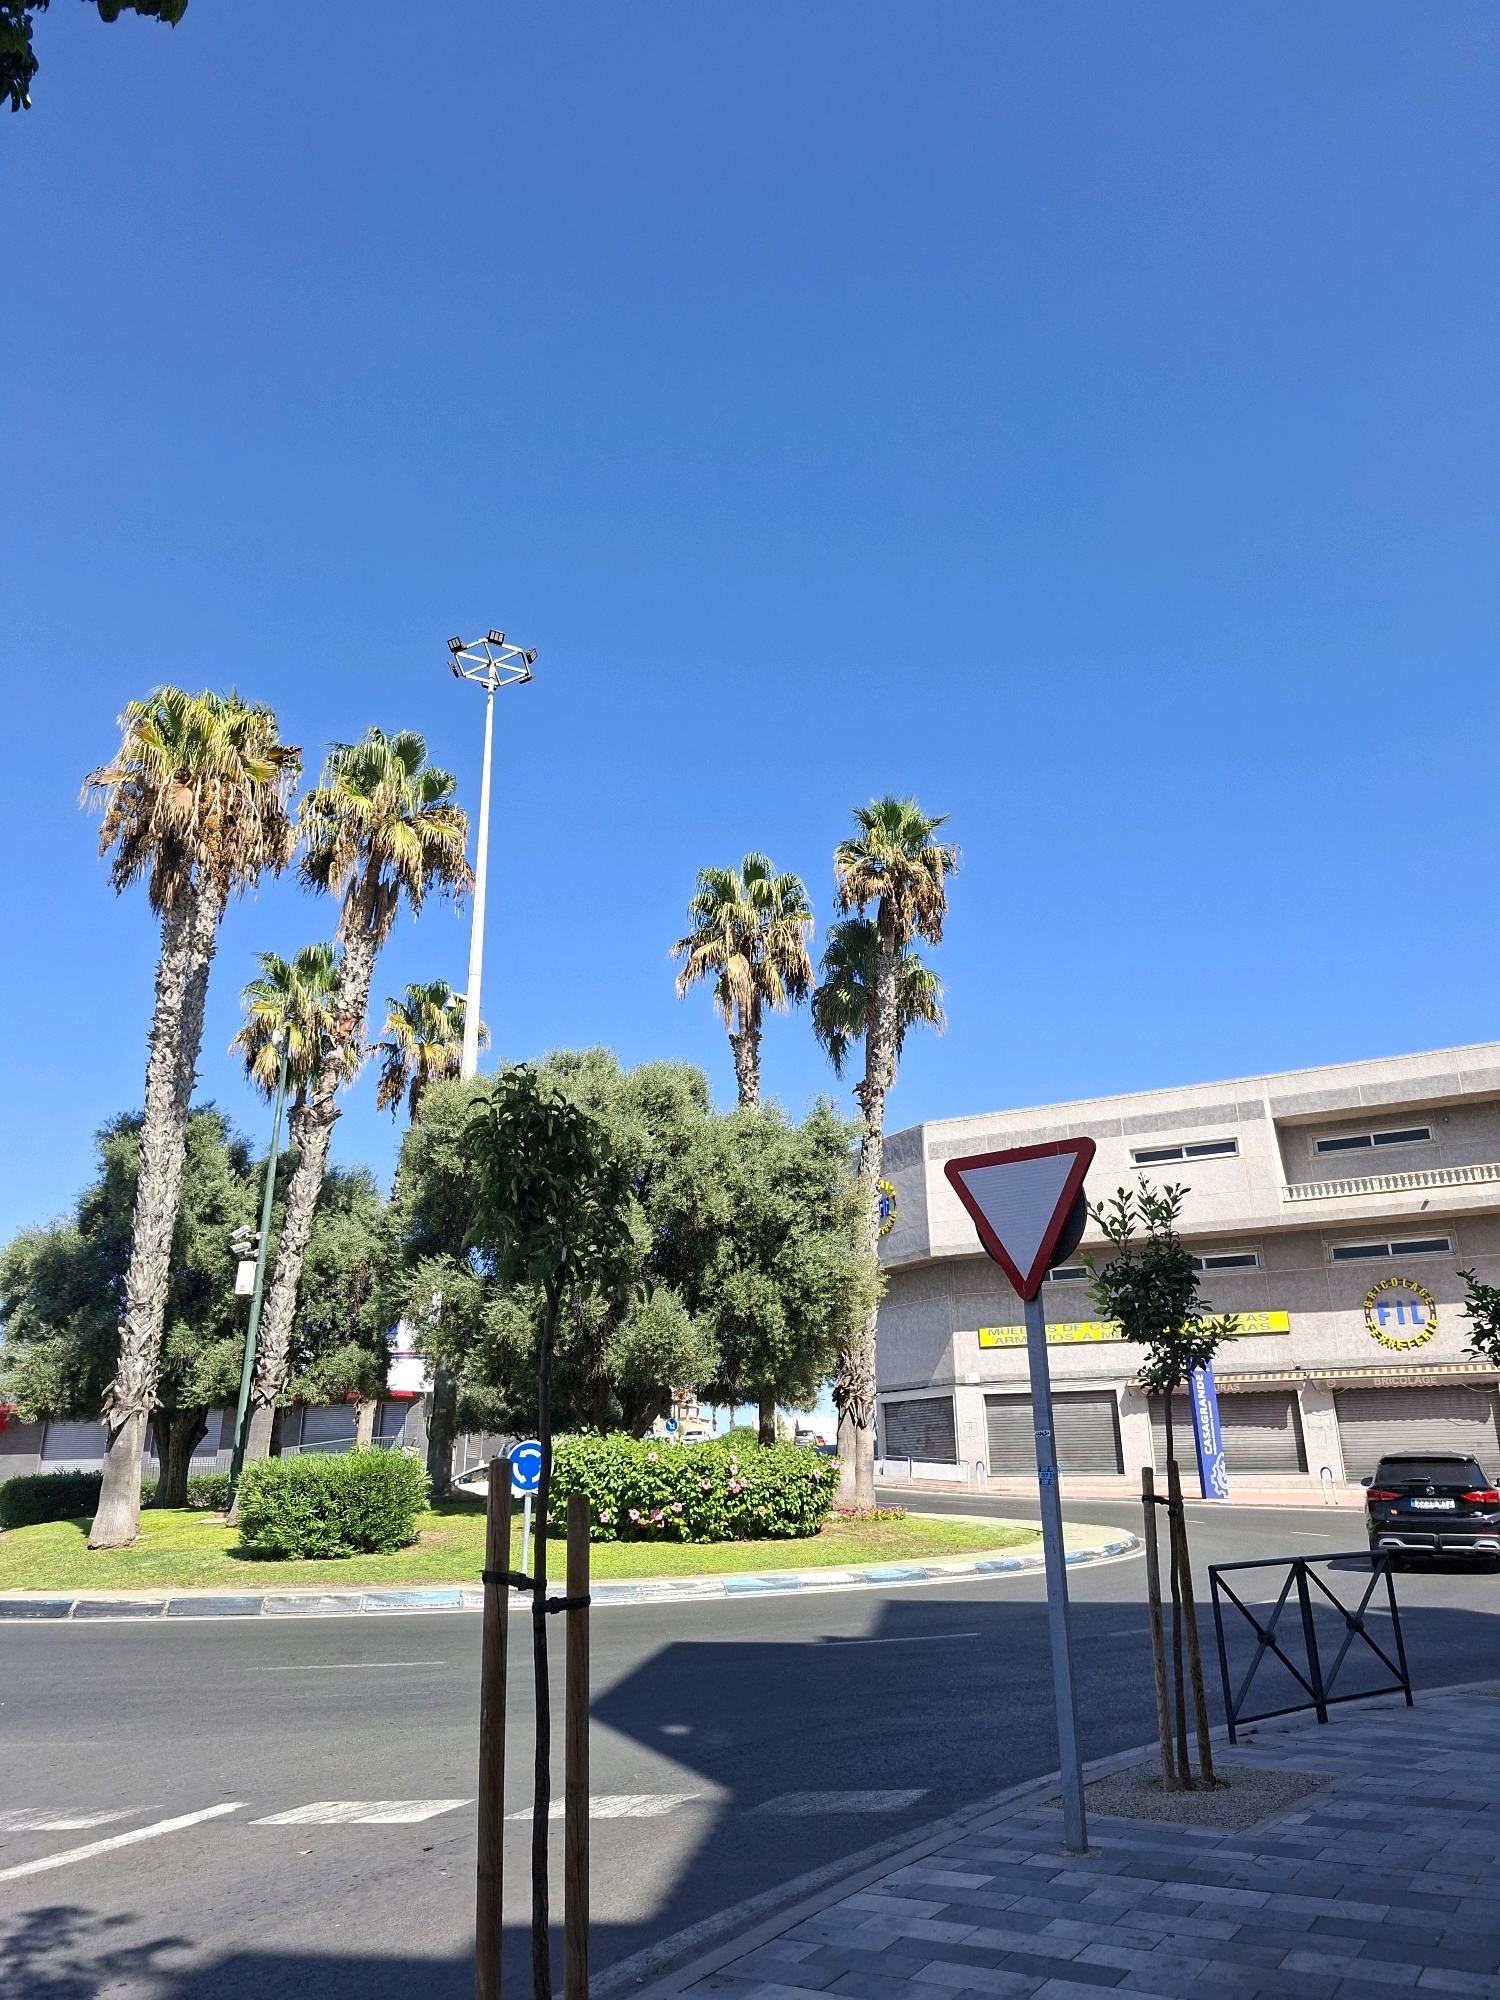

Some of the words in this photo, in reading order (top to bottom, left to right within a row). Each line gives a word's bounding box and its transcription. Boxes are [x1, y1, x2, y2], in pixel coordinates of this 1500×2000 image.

[1363, 1277, 1435, 1309] BRICOLAGE
[1376, 1300, 1425, 1326] FIL
[988, 1323, 1057, 1336] MUEBS
[1062, 1322, 1083, 1332] DE
[994, 1332, 1074, 1345] ARMIOS
[1082, 1332, 1094, 1340] A
[1374, 1375, 1438, 1386] BRICOLAGE
[1196, 1374, 1213, 1455] CASAGRANDE
